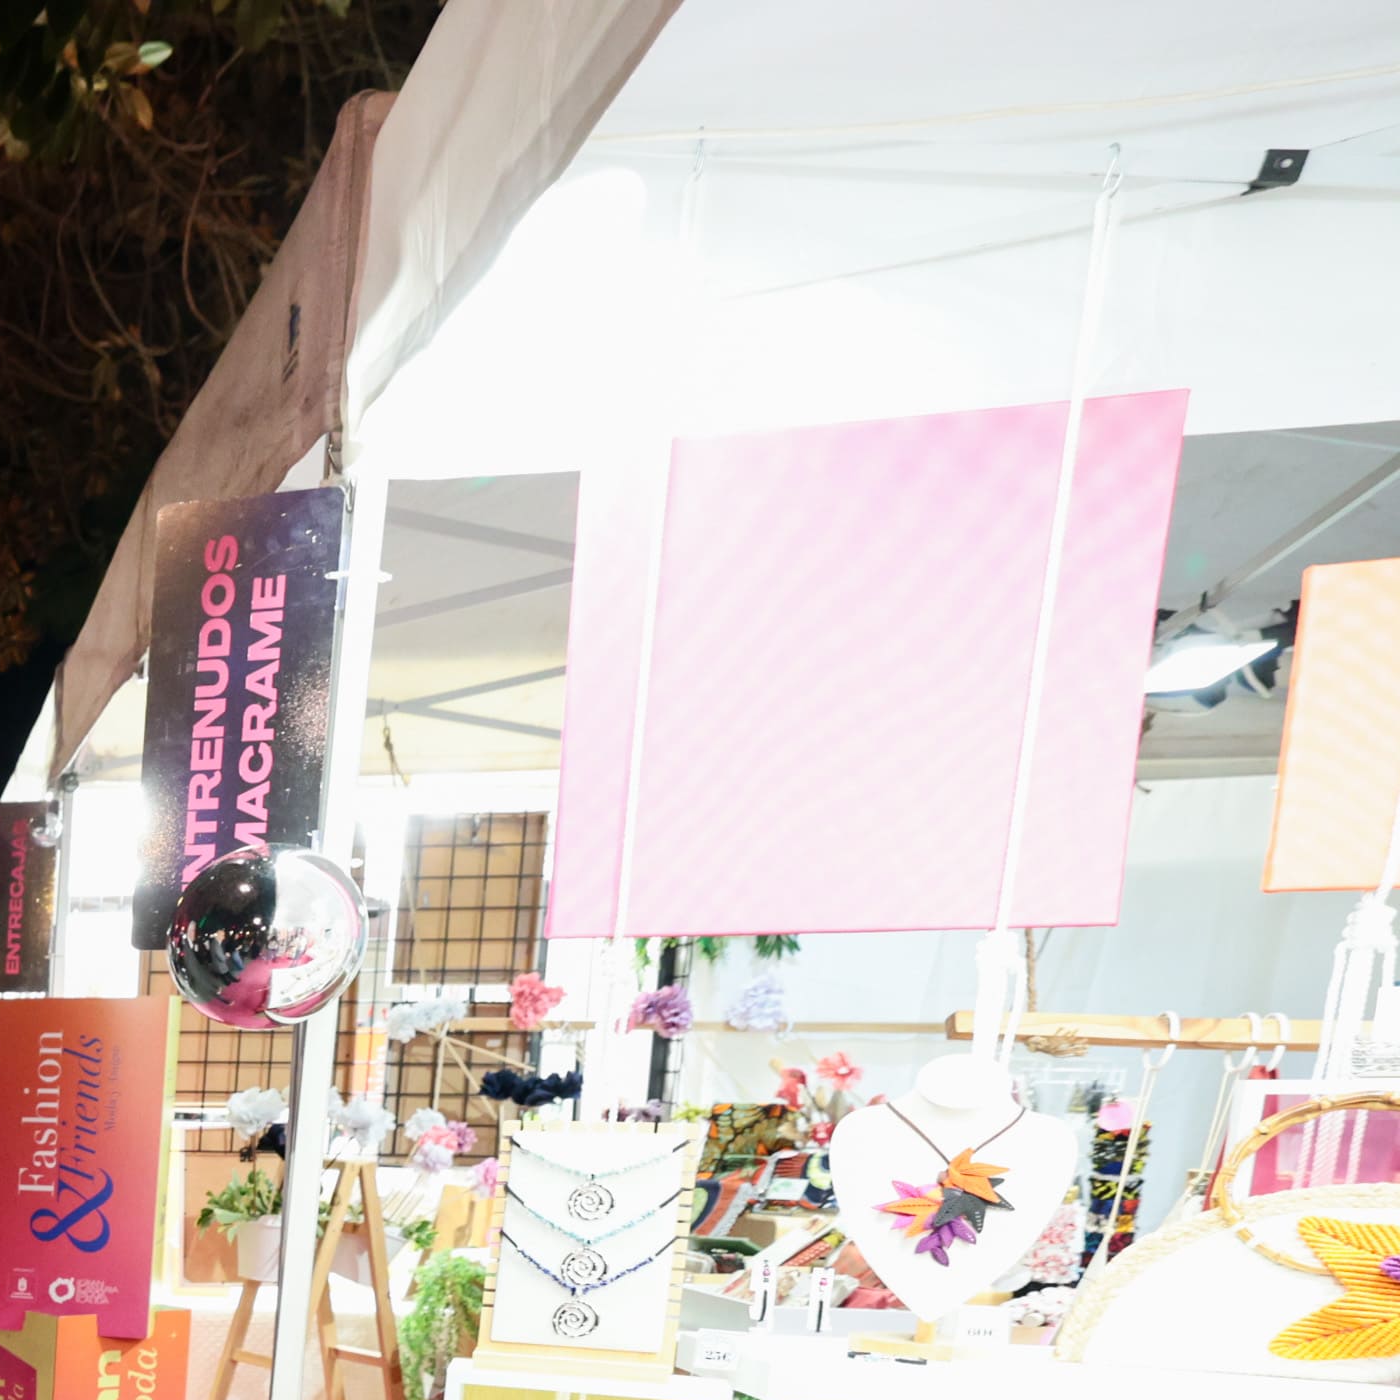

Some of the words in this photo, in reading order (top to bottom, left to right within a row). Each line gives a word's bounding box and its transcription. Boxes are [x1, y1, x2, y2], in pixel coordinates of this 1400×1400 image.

[181, 534, 239, 892] NTRENUDOS
[4, 819, 29, 976] ENTRECAJAS
[18, 1030, 64, 1197] Fashion
[58, 1034, 104, 1181] Friends
[30, 1167, 114, 1253] &
